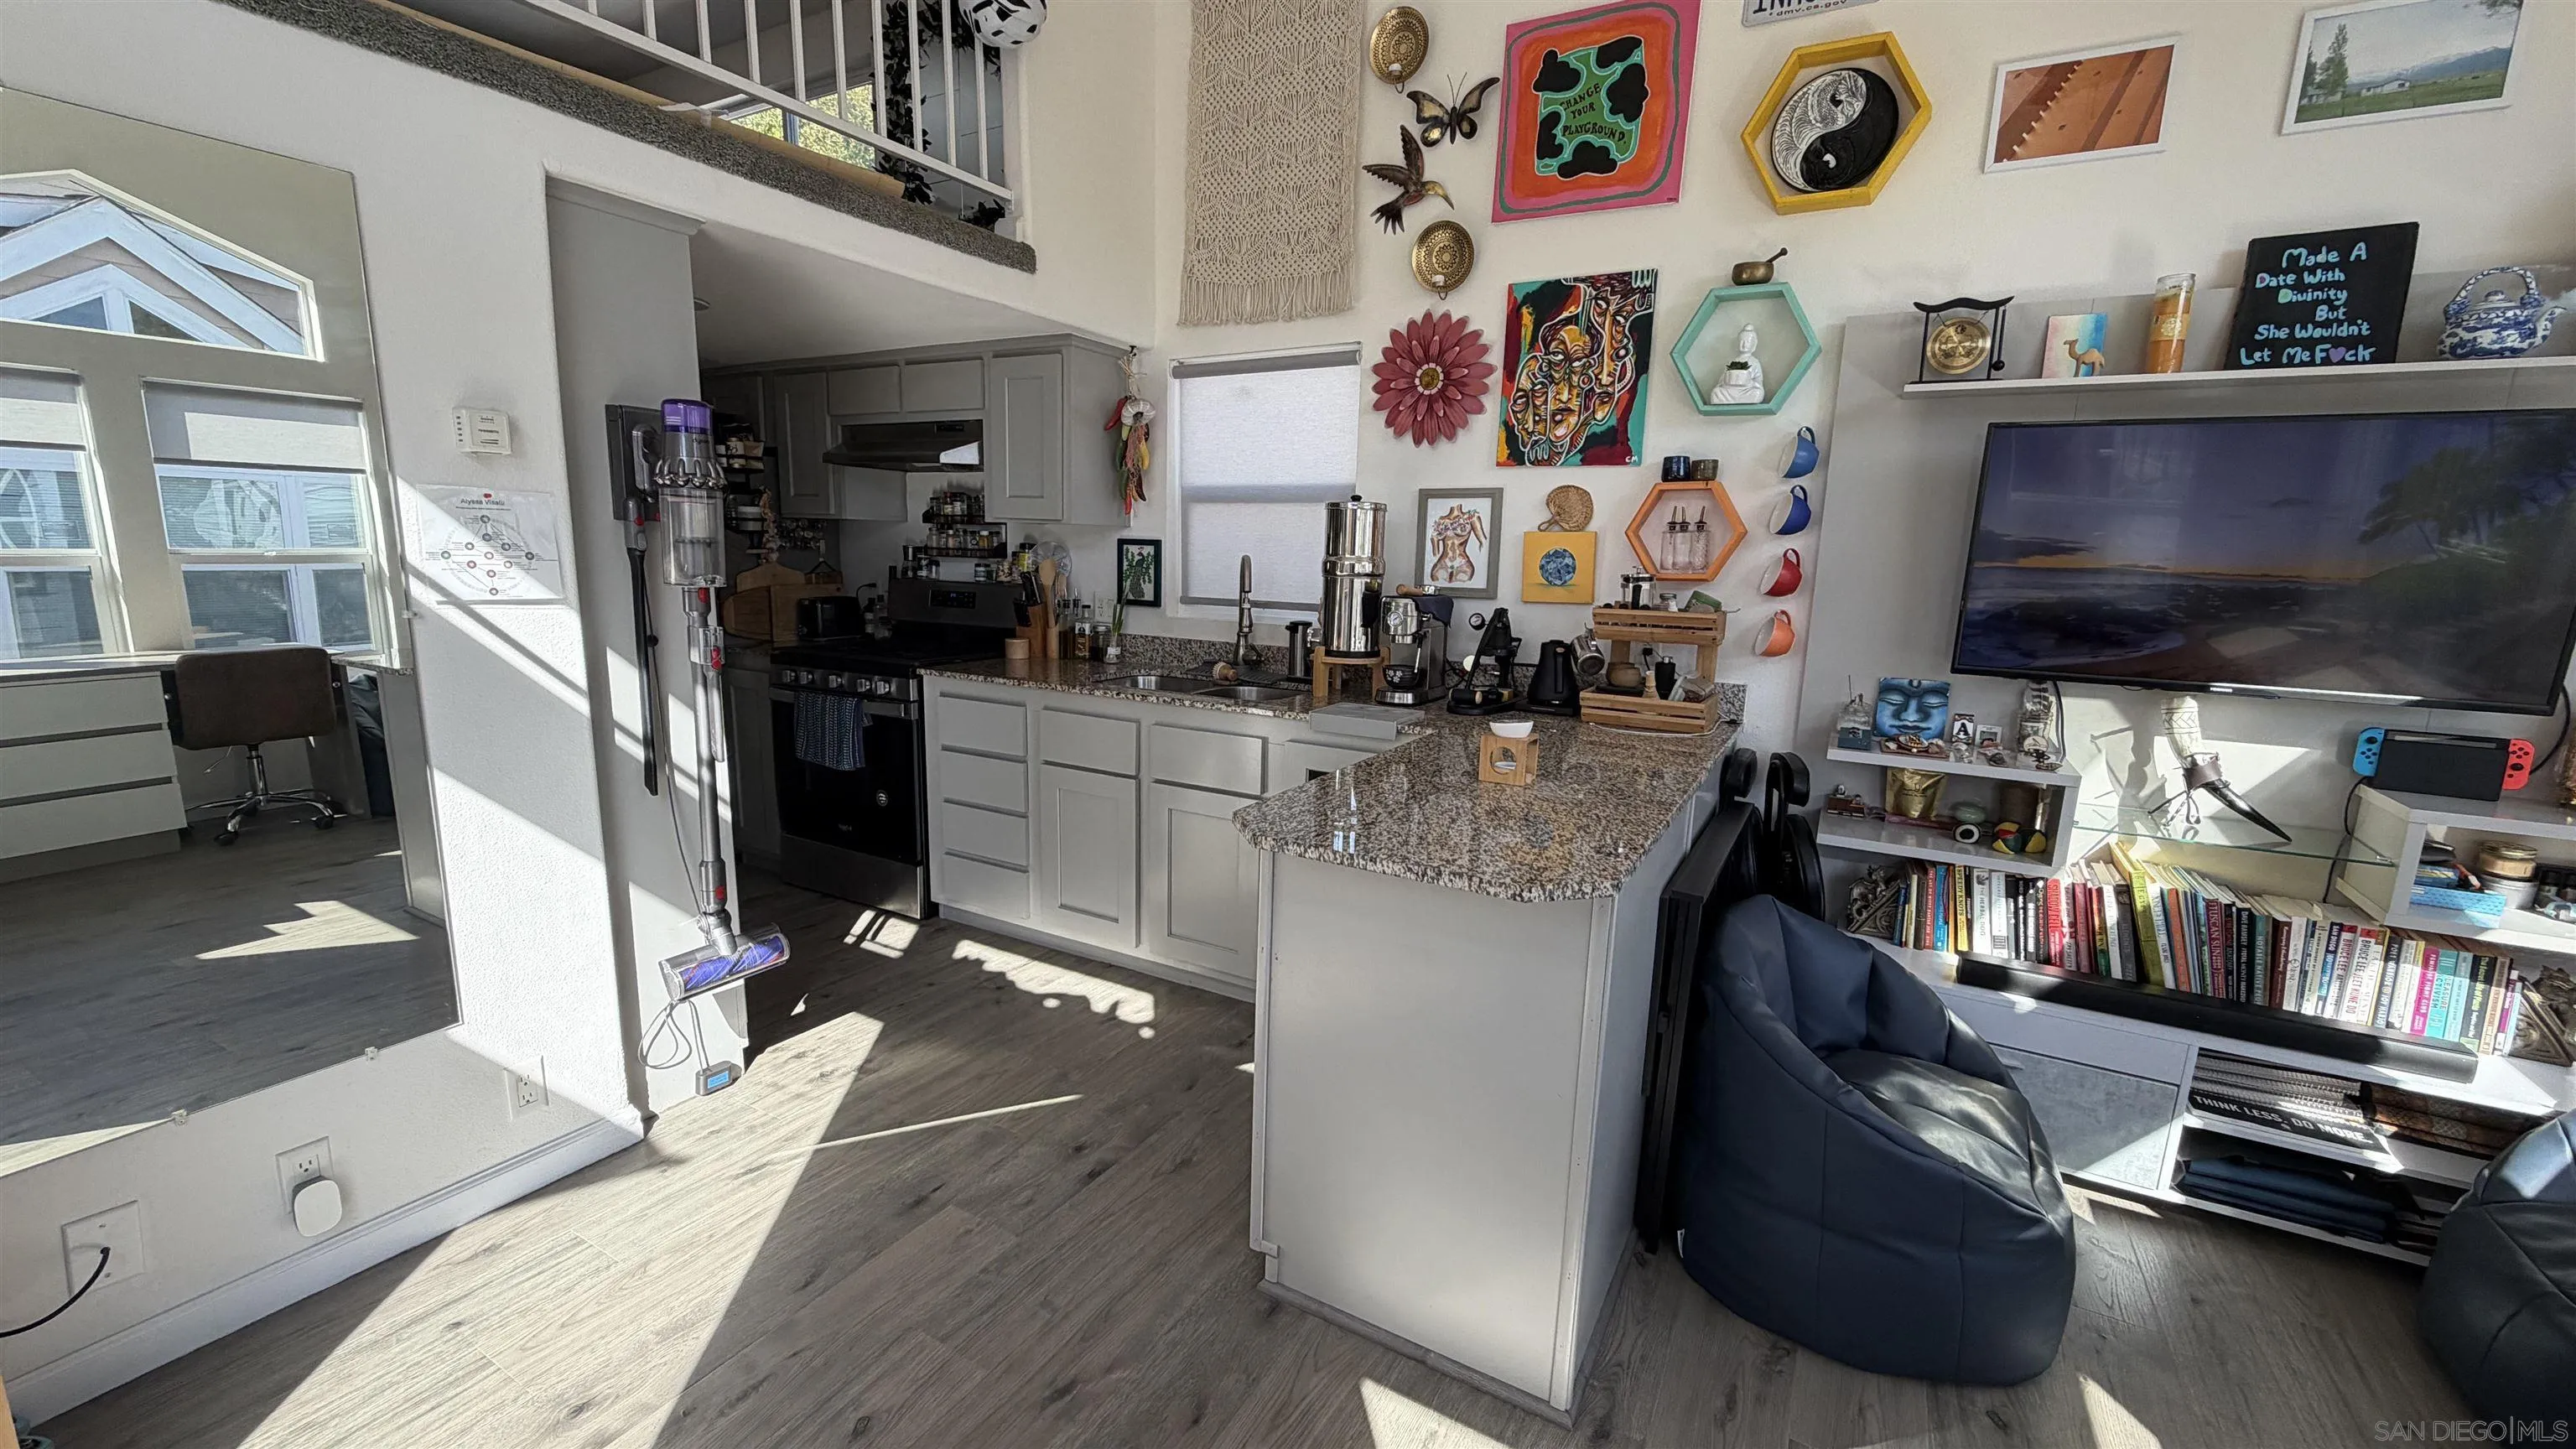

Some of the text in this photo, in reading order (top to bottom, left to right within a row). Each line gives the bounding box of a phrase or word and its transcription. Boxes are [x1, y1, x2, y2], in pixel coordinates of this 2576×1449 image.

[1776, 0, 1846, 16] dmv.ca.gov
[1560, 83, 1601, 111] CHANGE
[1571, 102, 1596, 119] YOUR
[2282, 242, 2367, 268] Made A
[2255, 268, 2345, 288] Date With
[2278, 288, 2348, 305] Divinity
[2315, 305, 2348, 321] But
[2254, 319, 2371, 340] She Wouldn't
[2241, 347, 2272, 366] Let
[2283, 346, 2311, 364] Me
[1625, 454, 1639, 463] CM
[1956, 722, 1971, 736] A
[2048, 885, 2059, 912] SHADOW
[2208, 905, 2219, 937] TUSCAN
[2210, 939, 2220, 956] SUN
[2255, 936, 2263, 963] NOTABLE
[2328, 935, 2337, 951] DIEGO
[2339, 937, 2353, 960] BRUCE
[2357, 938, 2371, 961] BRUCE
[2389, 943, 2398, 958] POET
[2336, 959, 2348, 972] LEE
[2354, 960, 2366, 974] LEE
[2383, 959, 2397, 985] WARRIOR
[2347, 987, 2360, 1005] KUNE
[2422, 980, 2431, 998] FIGHT
[2380, 994, 2389, 1005] JOY
[2419, 999, 2428, 1013] CLUB
[2345, 1004, 2356, 1015] DO
[2194, 1095, 2242, 1114] THINK
[2292, 1118, 2315, 1130] DO
